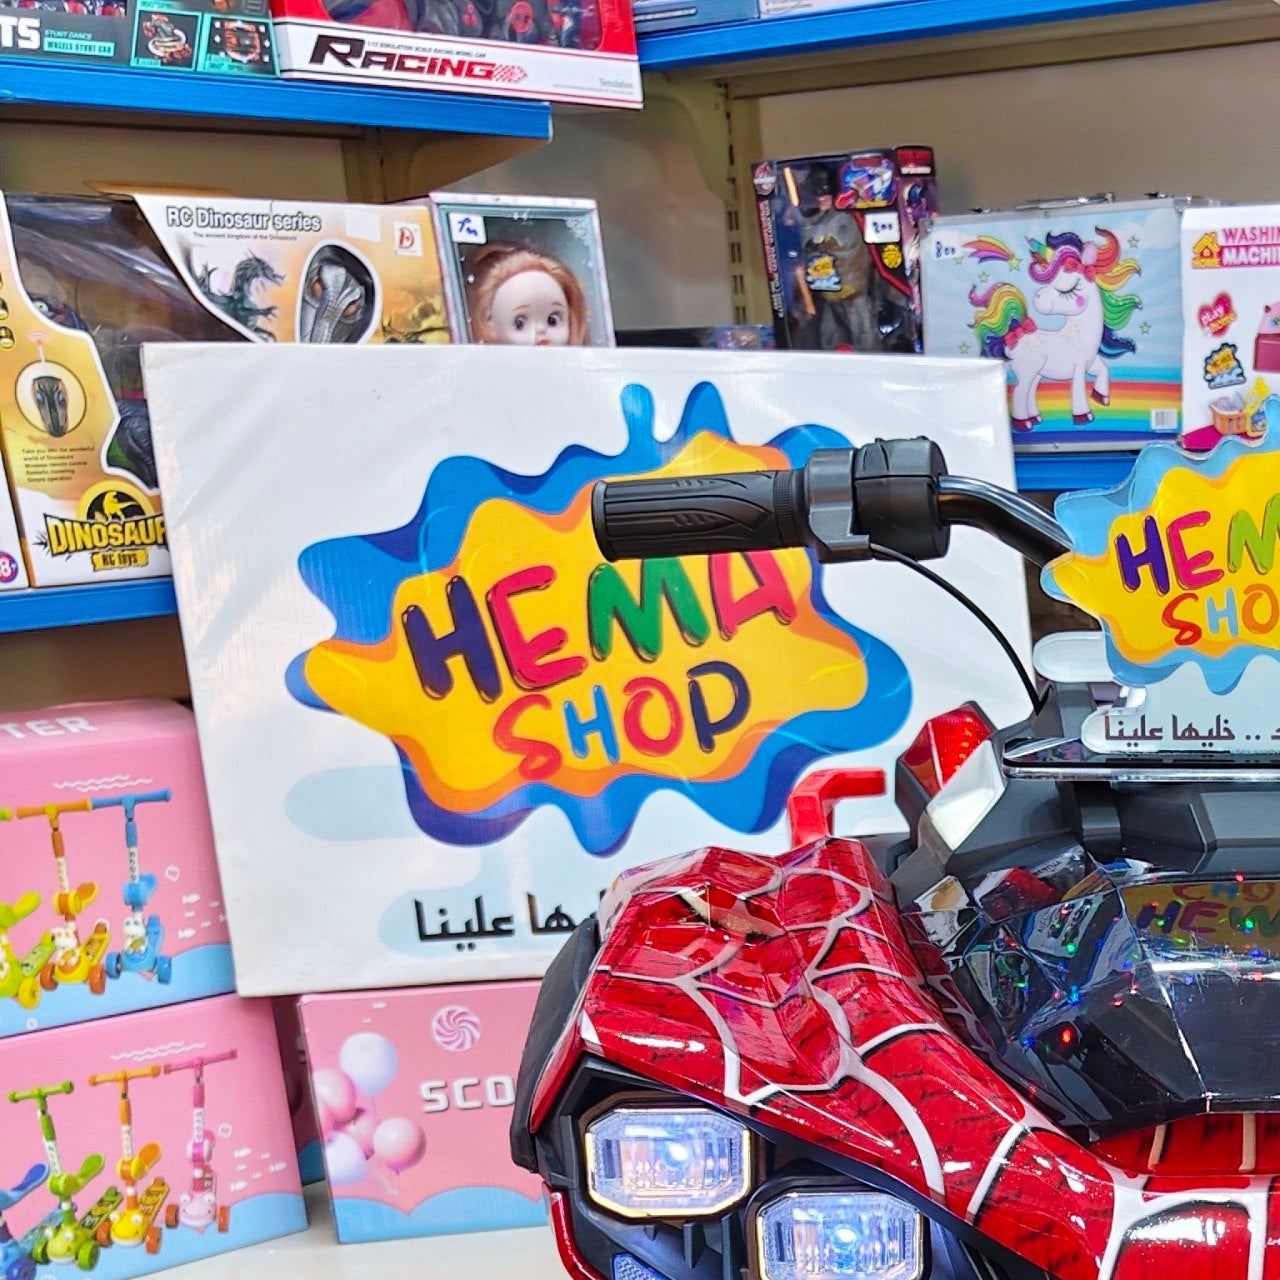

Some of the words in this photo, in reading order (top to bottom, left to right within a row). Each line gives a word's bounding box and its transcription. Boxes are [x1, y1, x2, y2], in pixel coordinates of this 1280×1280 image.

[309, 33, 497, 81] RACING
[166, 206, 194, 227] RC
[196, 207, 270, 230] Dinosaur
[272, 211, 321, 232] series
[401, 550, 798, 703] HEMA
[1, 714, 98, 740] TER
[493, 660, 751, 781] SHOP
[1105, 714, 1164, 747] علينا
[1172, 714, 1236, 747] خليها
[414, 894, 515, 951] علينا
